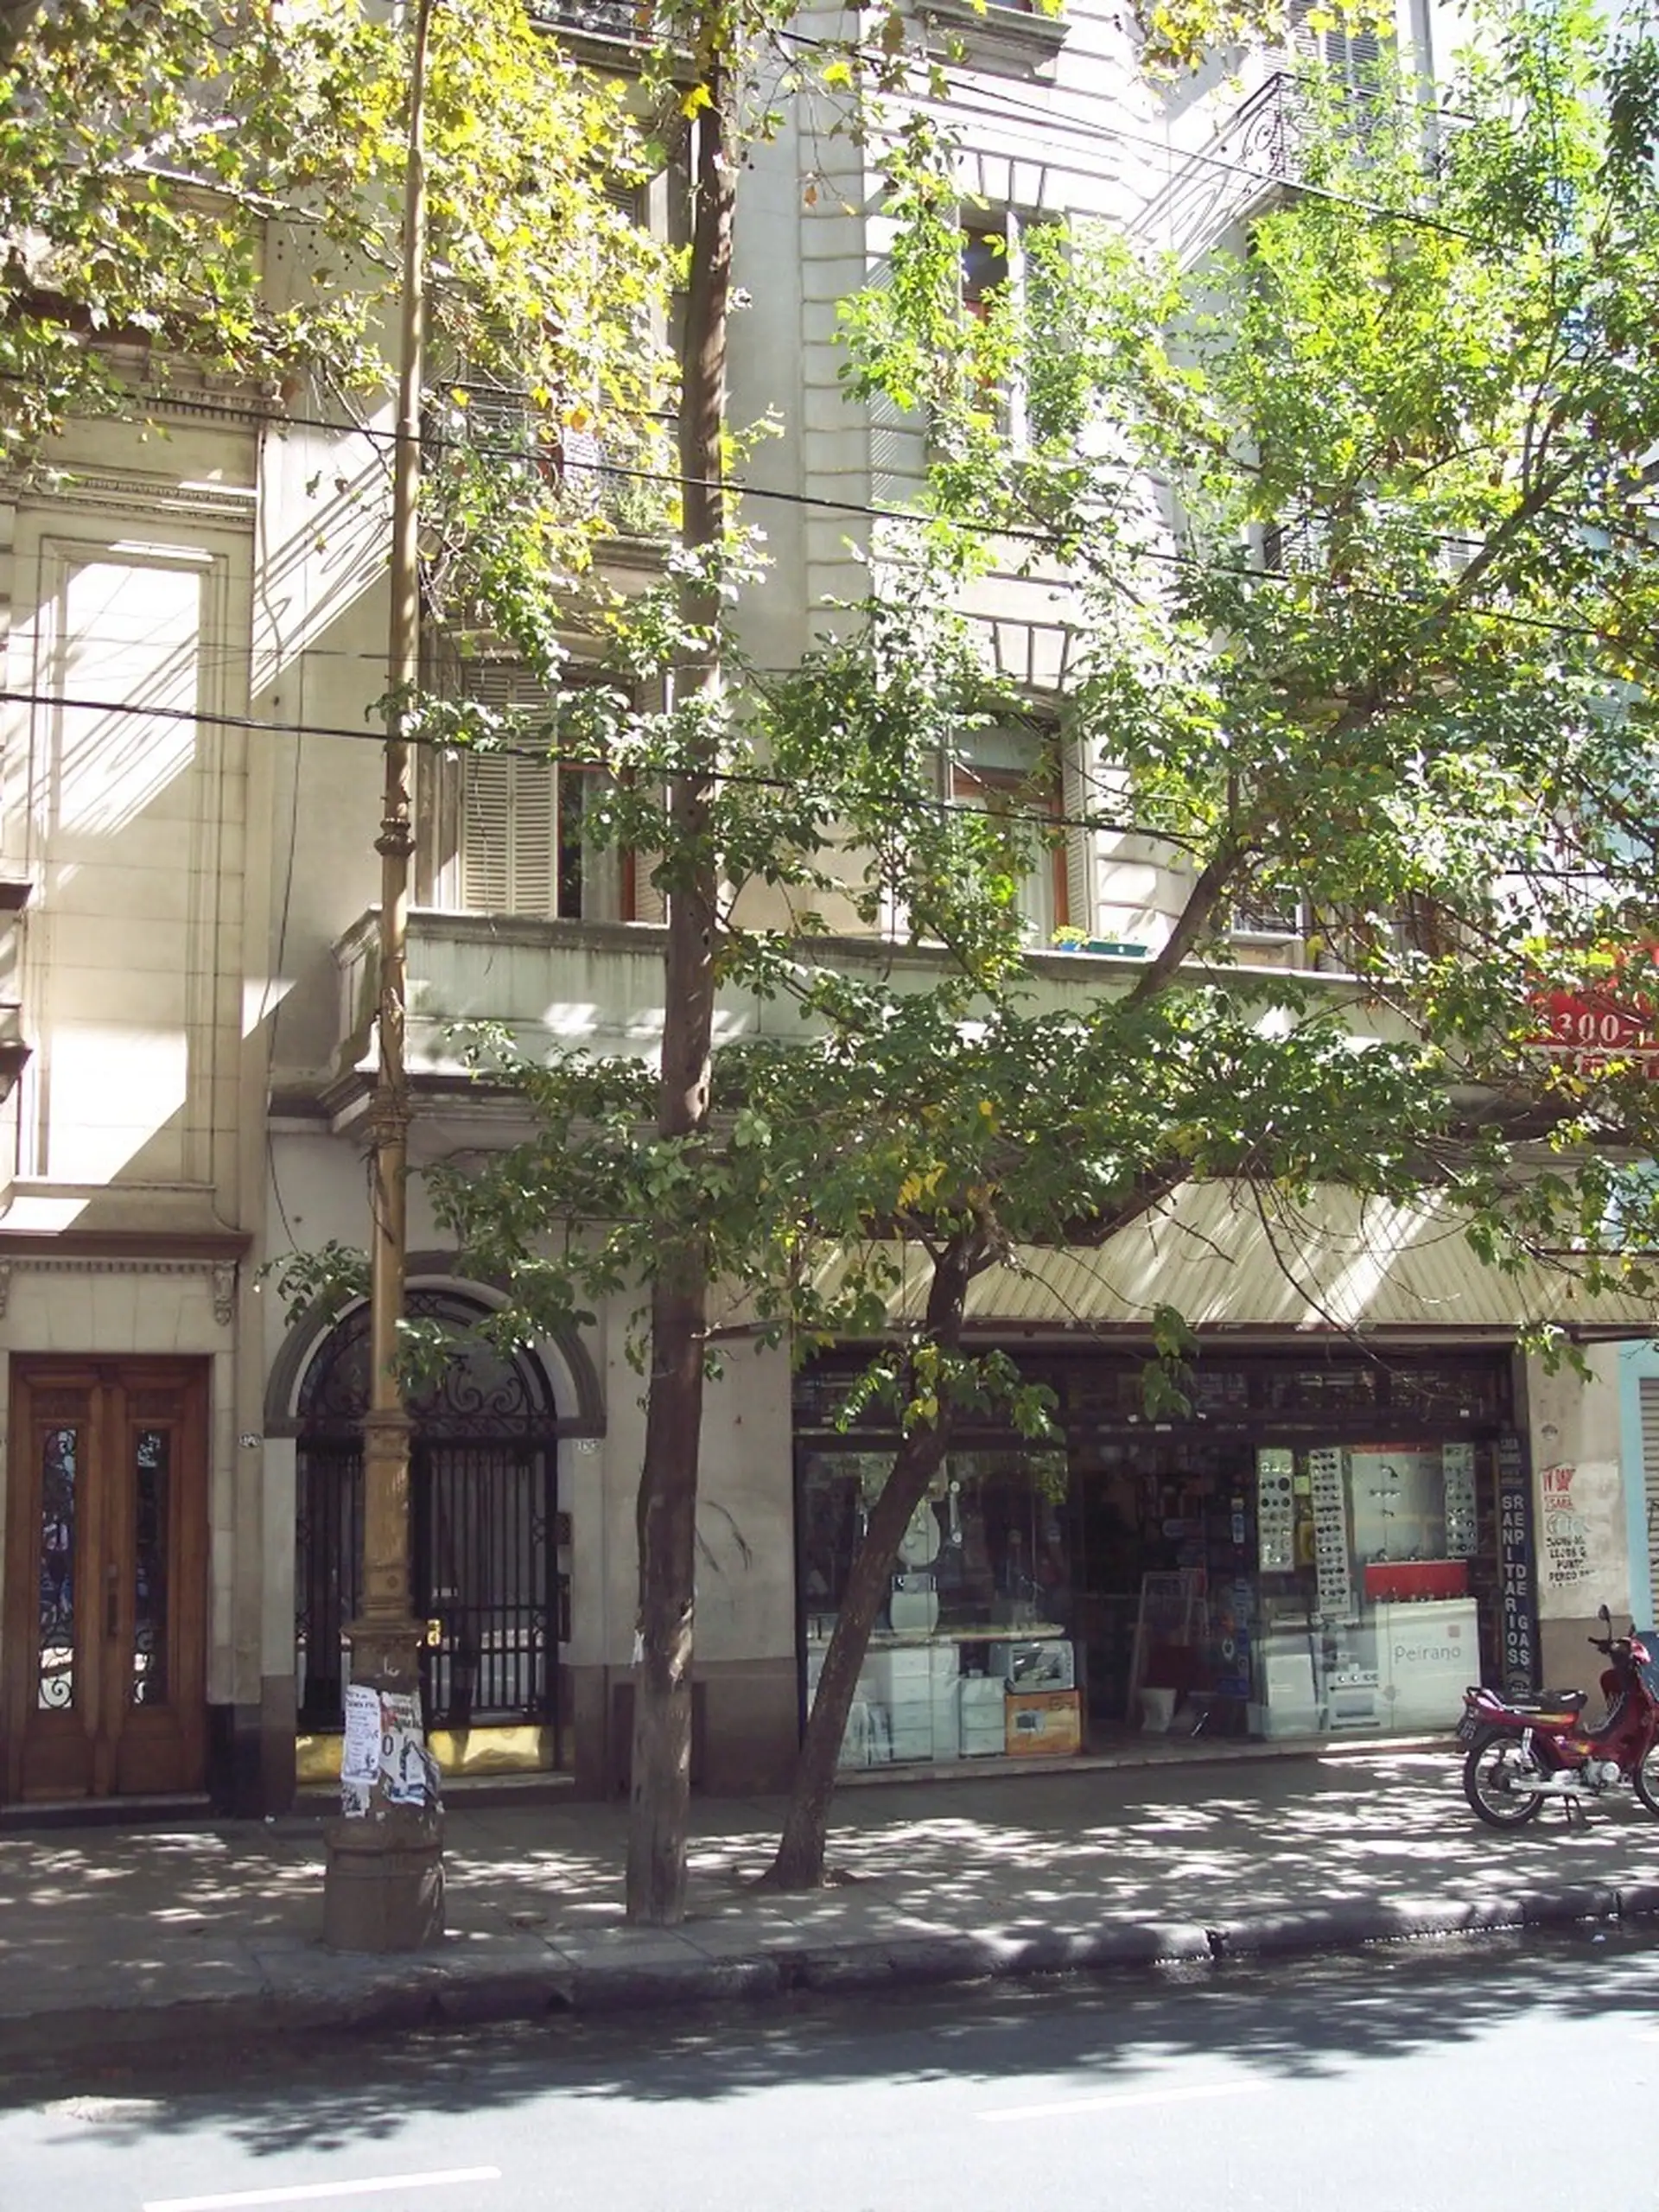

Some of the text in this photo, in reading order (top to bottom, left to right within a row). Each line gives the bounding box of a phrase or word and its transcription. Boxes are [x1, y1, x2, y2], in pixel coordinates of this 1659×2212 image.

[1501, 1495, 1519, 1664] SANITARIOS
[1515, 1562, 1528, 1597] DE
[1394, 1645, 1462, 1665] Peirano
[1517, 1614, 1530, 1667] GAS
